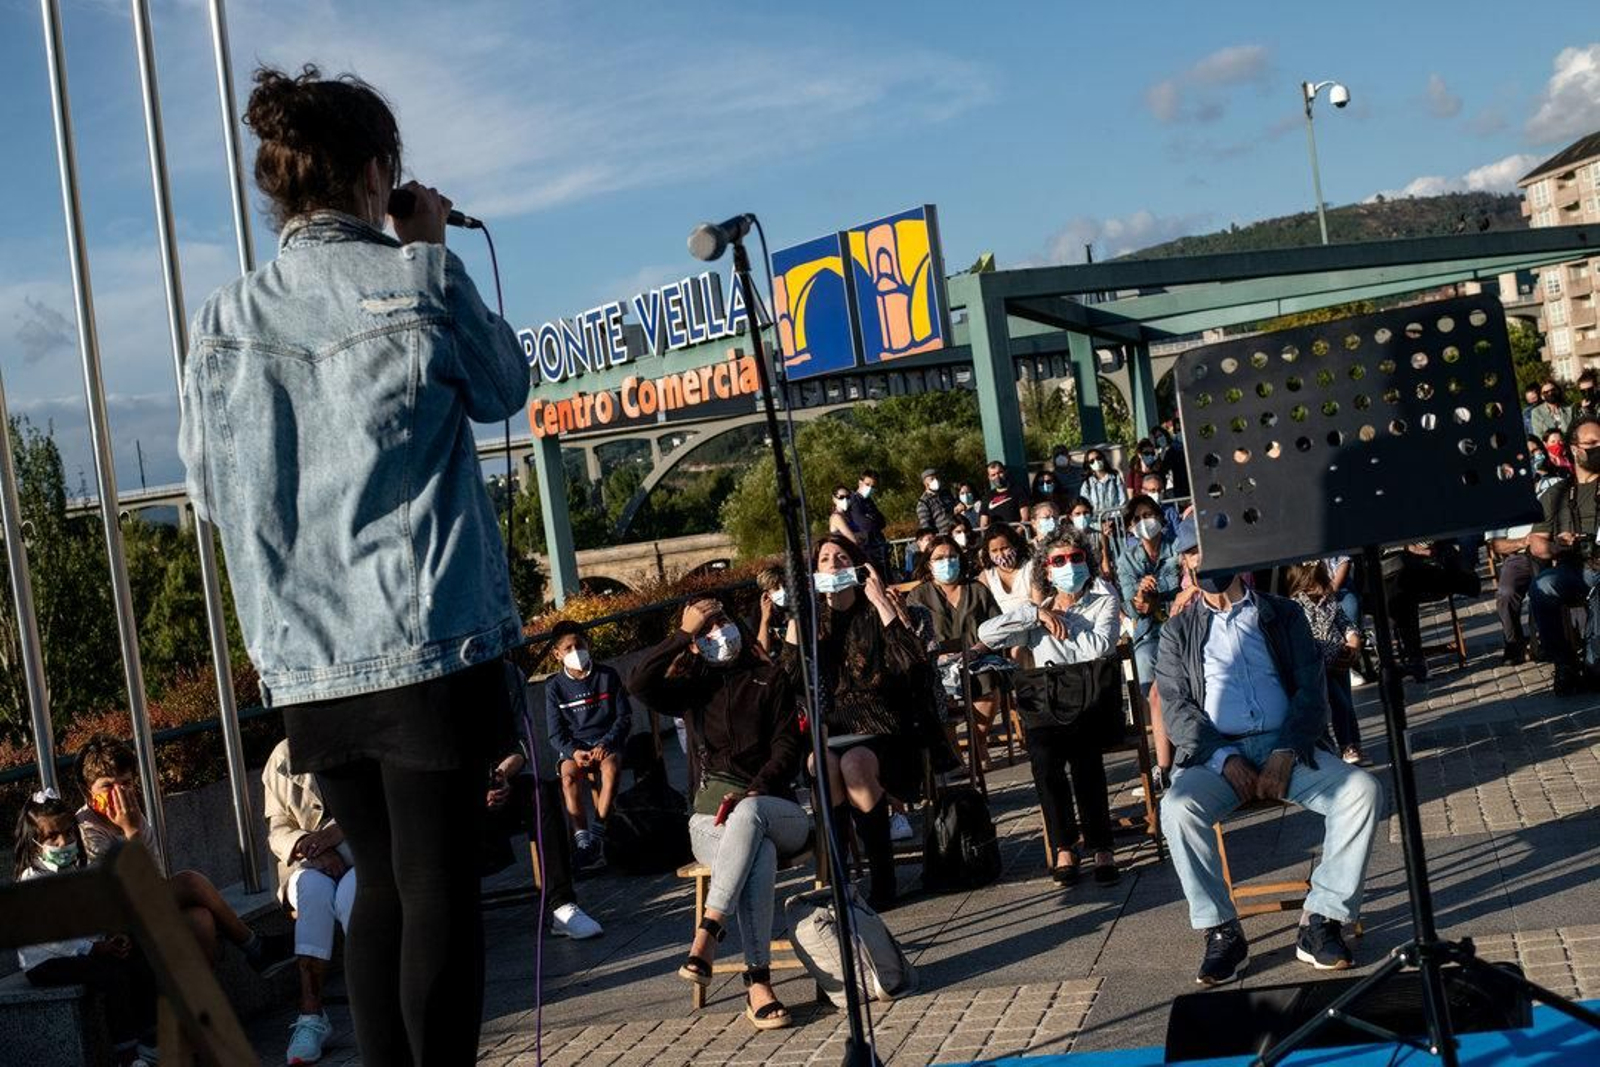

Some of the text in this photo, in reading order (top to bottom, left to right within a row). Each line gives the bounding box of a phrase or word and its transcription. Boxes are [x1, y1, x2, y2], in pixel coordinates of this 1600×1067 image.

[517, 266, 762, 382] PONTE VELLA
[529, 346, 764, 438] Centro Comercia
